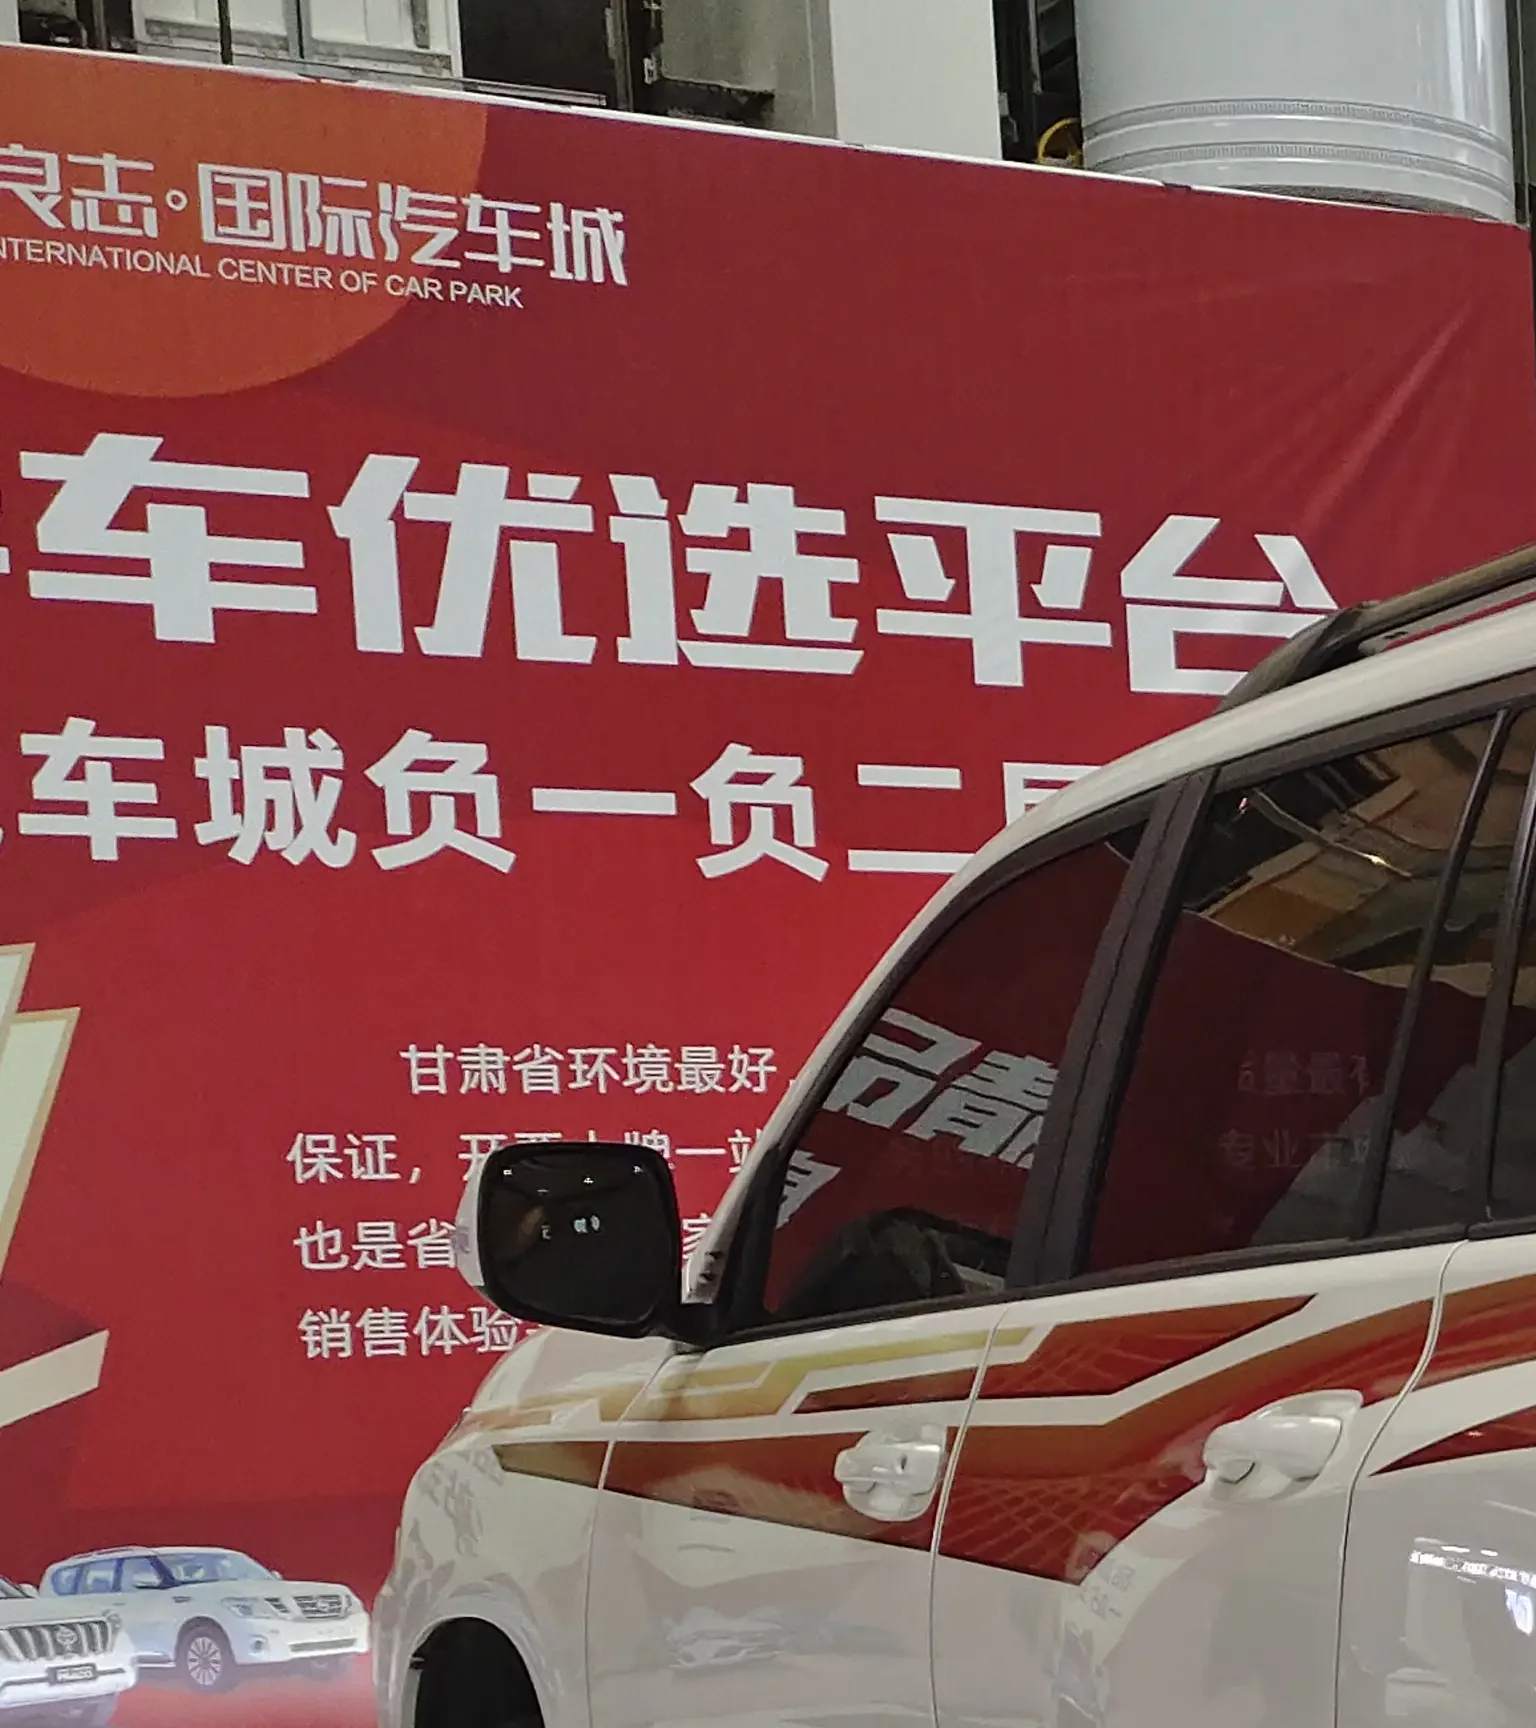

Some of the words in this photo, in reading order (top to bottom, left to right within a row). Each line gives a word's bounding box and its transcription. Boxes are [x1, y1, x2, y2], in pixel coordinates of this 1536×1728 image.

[217, 257, 333, 290] CENTER
[339, 270, 378, 296] OF
[385, 275, 444, 301] CAR
[449, 281, 524, 309] PARK
[0, 433, 1338, 697] 车优选平台
[0, 717, 1100, 883] 车城负一负二
[400, 1043, 777, 1096] 甘肃省环境最好
[298, 1304, 542, 1359] 销售体验
